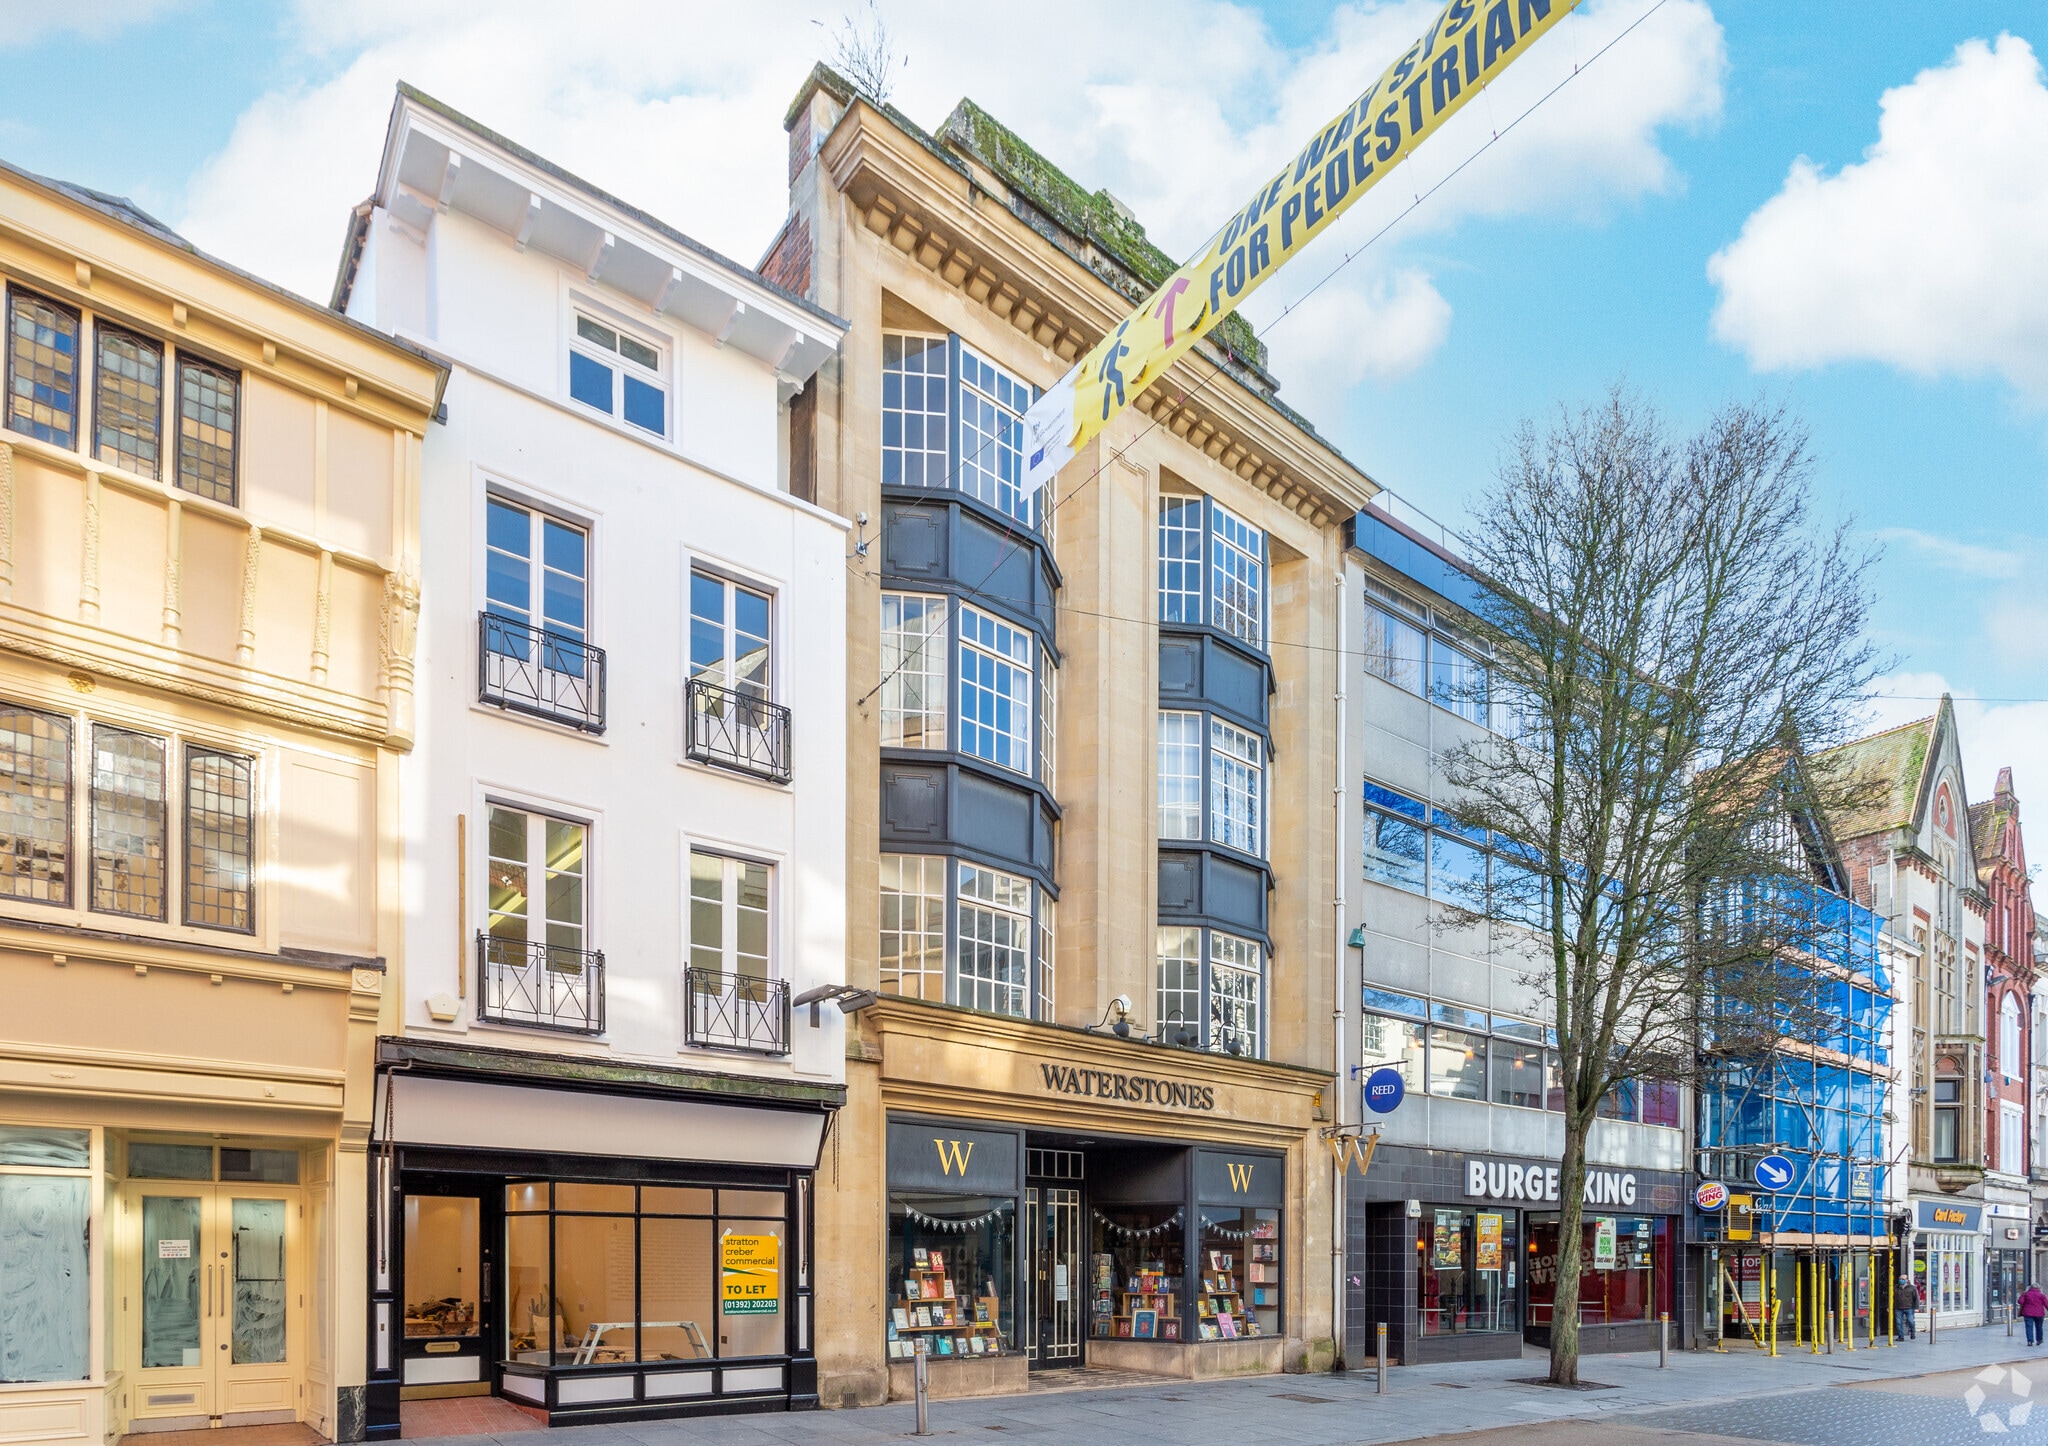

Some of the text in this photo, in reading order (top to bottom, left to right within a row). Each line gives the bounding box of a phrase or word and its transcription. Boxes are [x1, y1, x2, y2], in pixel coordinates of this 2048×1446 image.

[1219, 0, 1490, 256] ONE WAY SYS
[1210, 0, 1552, 316] FOR PEDESTRIAN
[1041, 1063, 1215, 1111] WATERSTONES
[1371, 1084, 1396, 1096] REED
[933, 1138, 975, 1177] W
[1326, 1133, 1382, 1177] W
[1226, 1163, 1254, 1193] W
[1468, 1160, 1559, 1201] BURGE
[1583, 1170, 1636, 1206] KING
[1697, 1186, 1722, 1198] BURGER
[1699, 1191, 1723, 1205] KING
[905, 1206, 1001, 1230] WATERSTONES
[1934, 1207, 1967, 1226] Card Factory
[725, 1238, 759, 1246] stratton
[1599, 1236, 1611, 1246] NOW
[725, 1247, 754, 1256] creber
[1599, 1245, 1612, 1255] OPEN
[725, 1256, 775, 1265] commercial
[1733, 1257, 1761, 1268] STOP
[726, 1285, 767, 1294] TO LET
[724, 1300, 777, 1309] (01392) 202203
